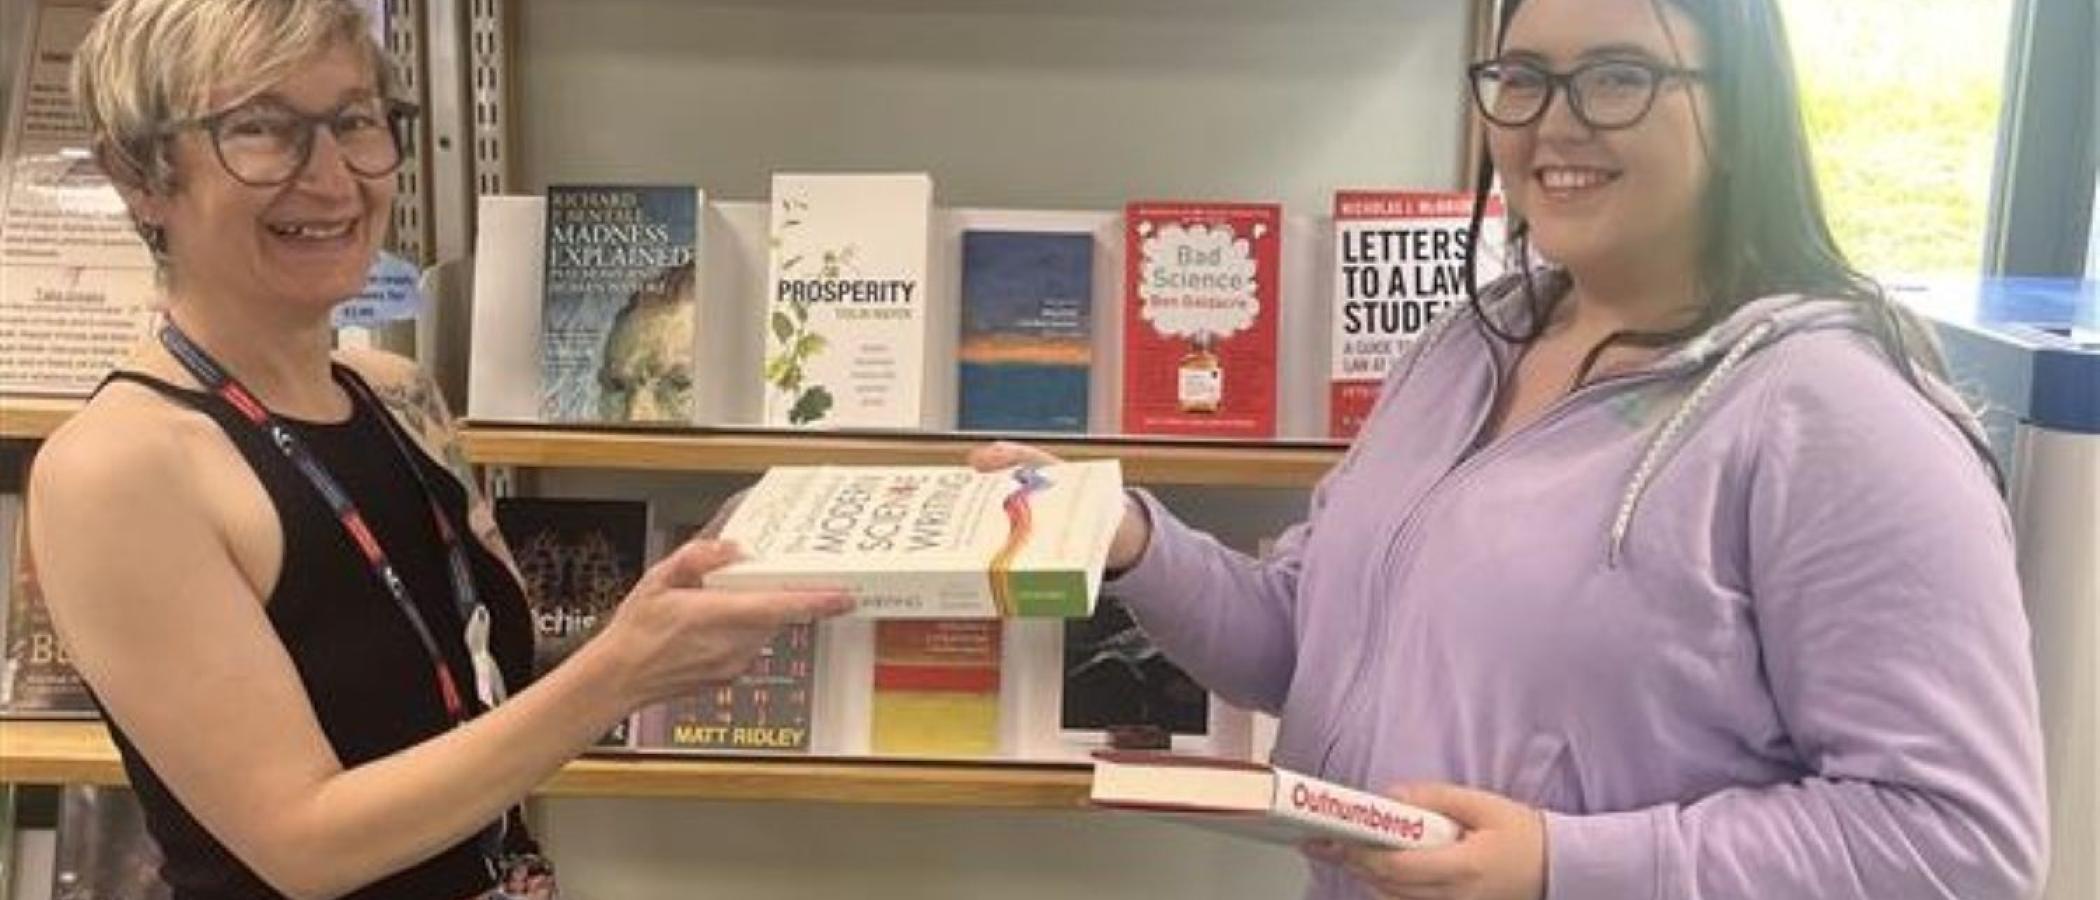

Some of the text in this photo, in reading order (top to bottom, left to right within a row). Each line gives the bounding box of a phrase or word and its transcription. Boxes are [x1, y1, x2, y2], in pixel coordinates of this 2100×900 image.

[552, 224, 668, 243] MADNESS
[551, 246, 691, 266] EXPLAINED
[1178, 245, 1221, 267] Bad
[1343, 229, 1469, 262] LETTERS
[777, 279, 915, 302] PROSPERITY
[1154, 268, 1242, 291] Science
[1343, 266, 1379, 298] TO
[1388, 266, 1407, 298] A
[1150, 295, 1247, 309] Ben Goldacre
[673, 725, 805, 746] MATT RIDLEY
[1294, 782, 1424, 840] Outnumbered
